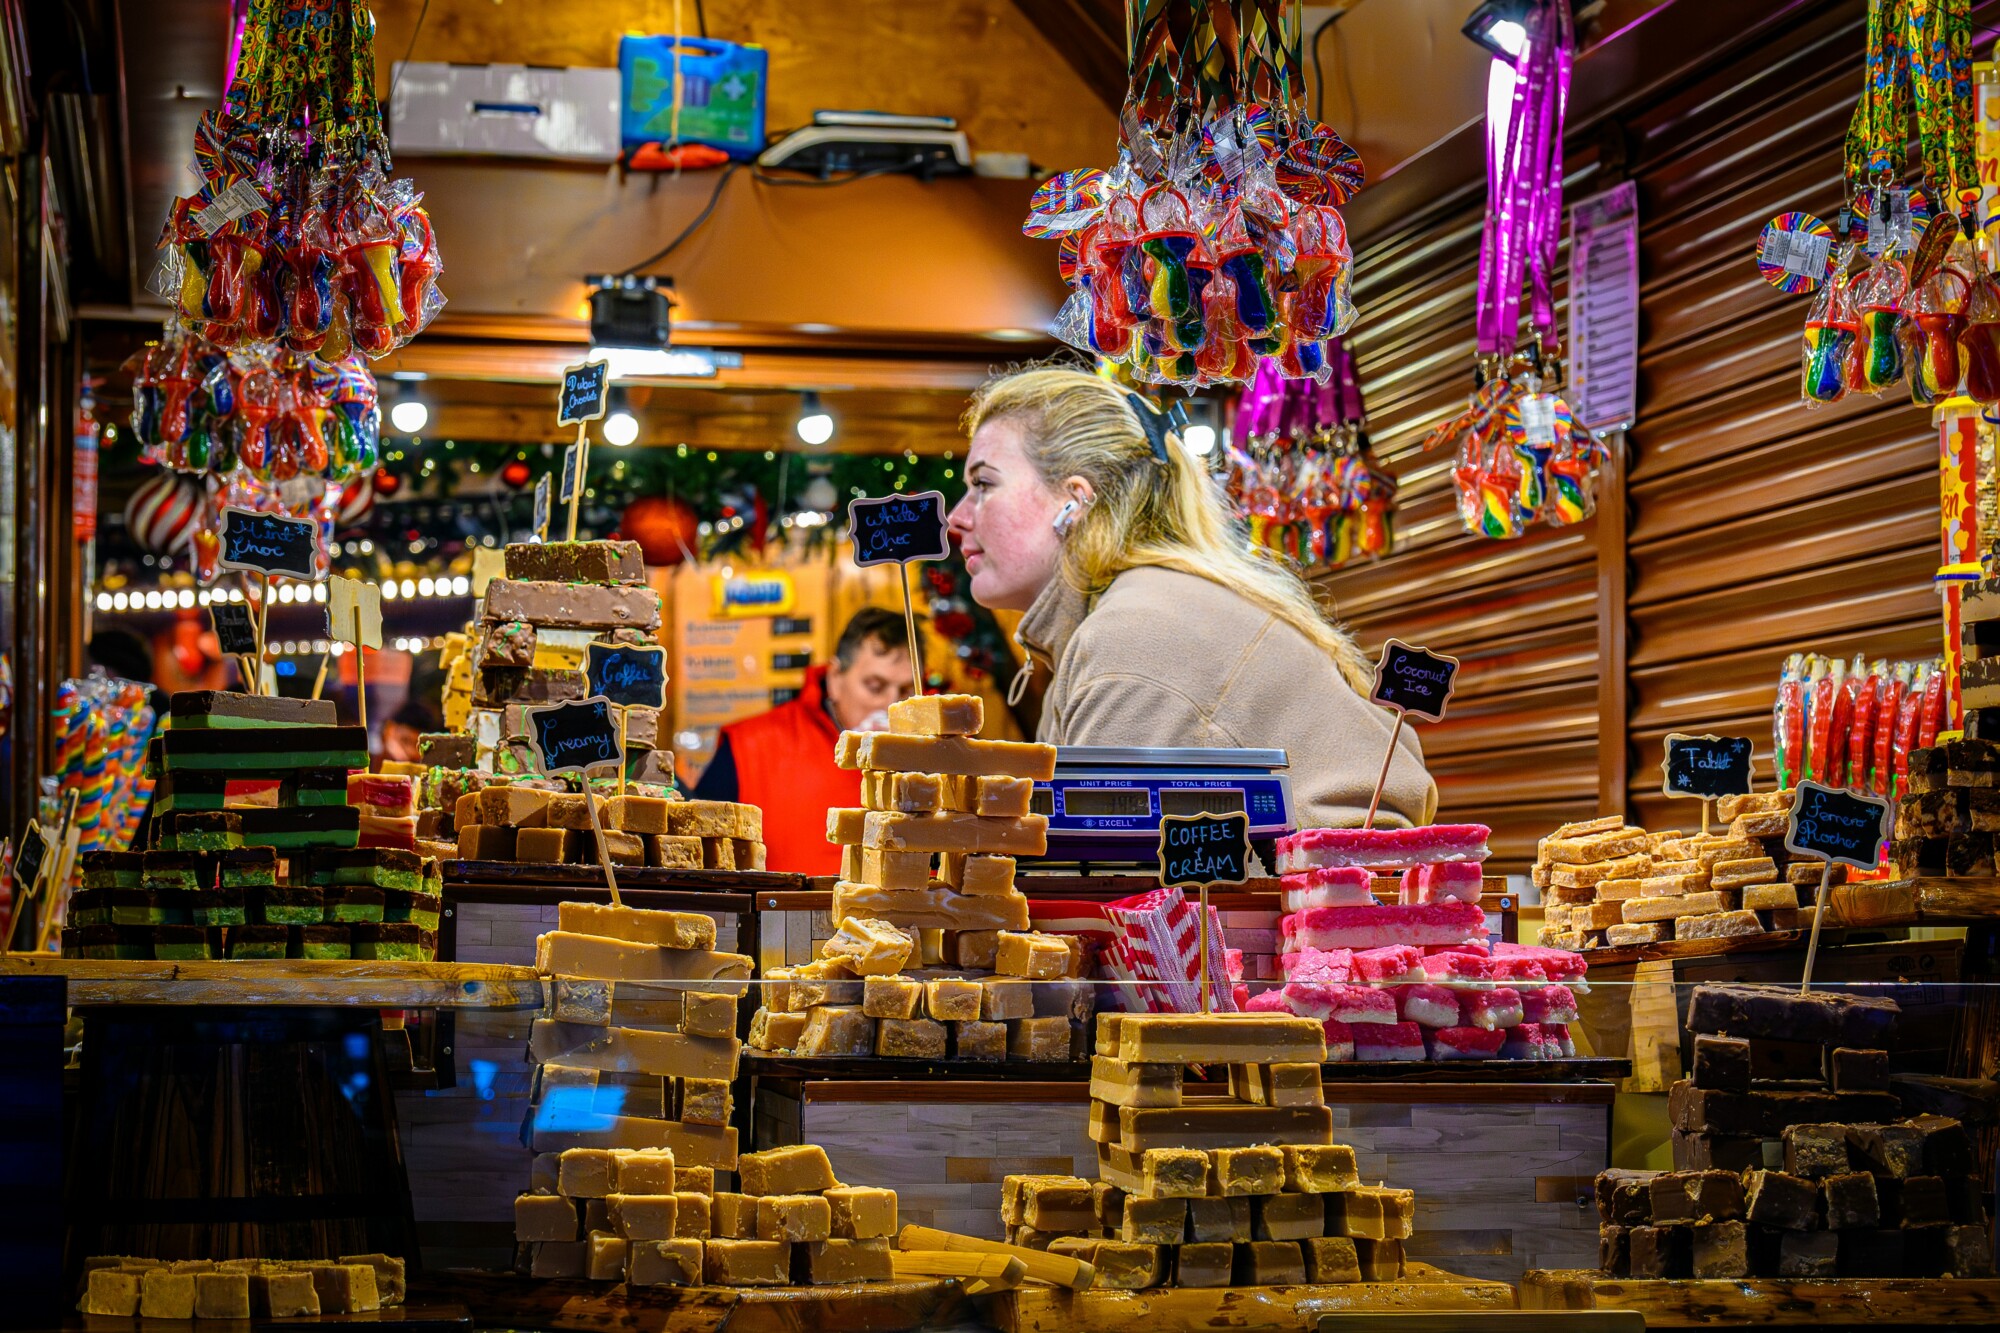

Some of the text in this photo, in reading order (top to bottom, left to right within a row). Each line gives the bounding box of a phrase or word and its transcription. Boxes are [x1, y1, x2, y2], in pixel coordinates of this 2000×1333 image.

[567, 373, 597, 392] Dubai
[602, 653, 651, 688] Coffee
[1393, 655, 1447, 684] Coconut
[1404, 679, 1432, 696] Ice
[543, 718, 610, 759] Creamy
[1098, 819, 1133, 827] EXCELL
[1169, 823, 1235, 846] COFFEE
[1798, 819, 1860, 848] Rocher
[1169, 854, 1237, 880] CREAM
